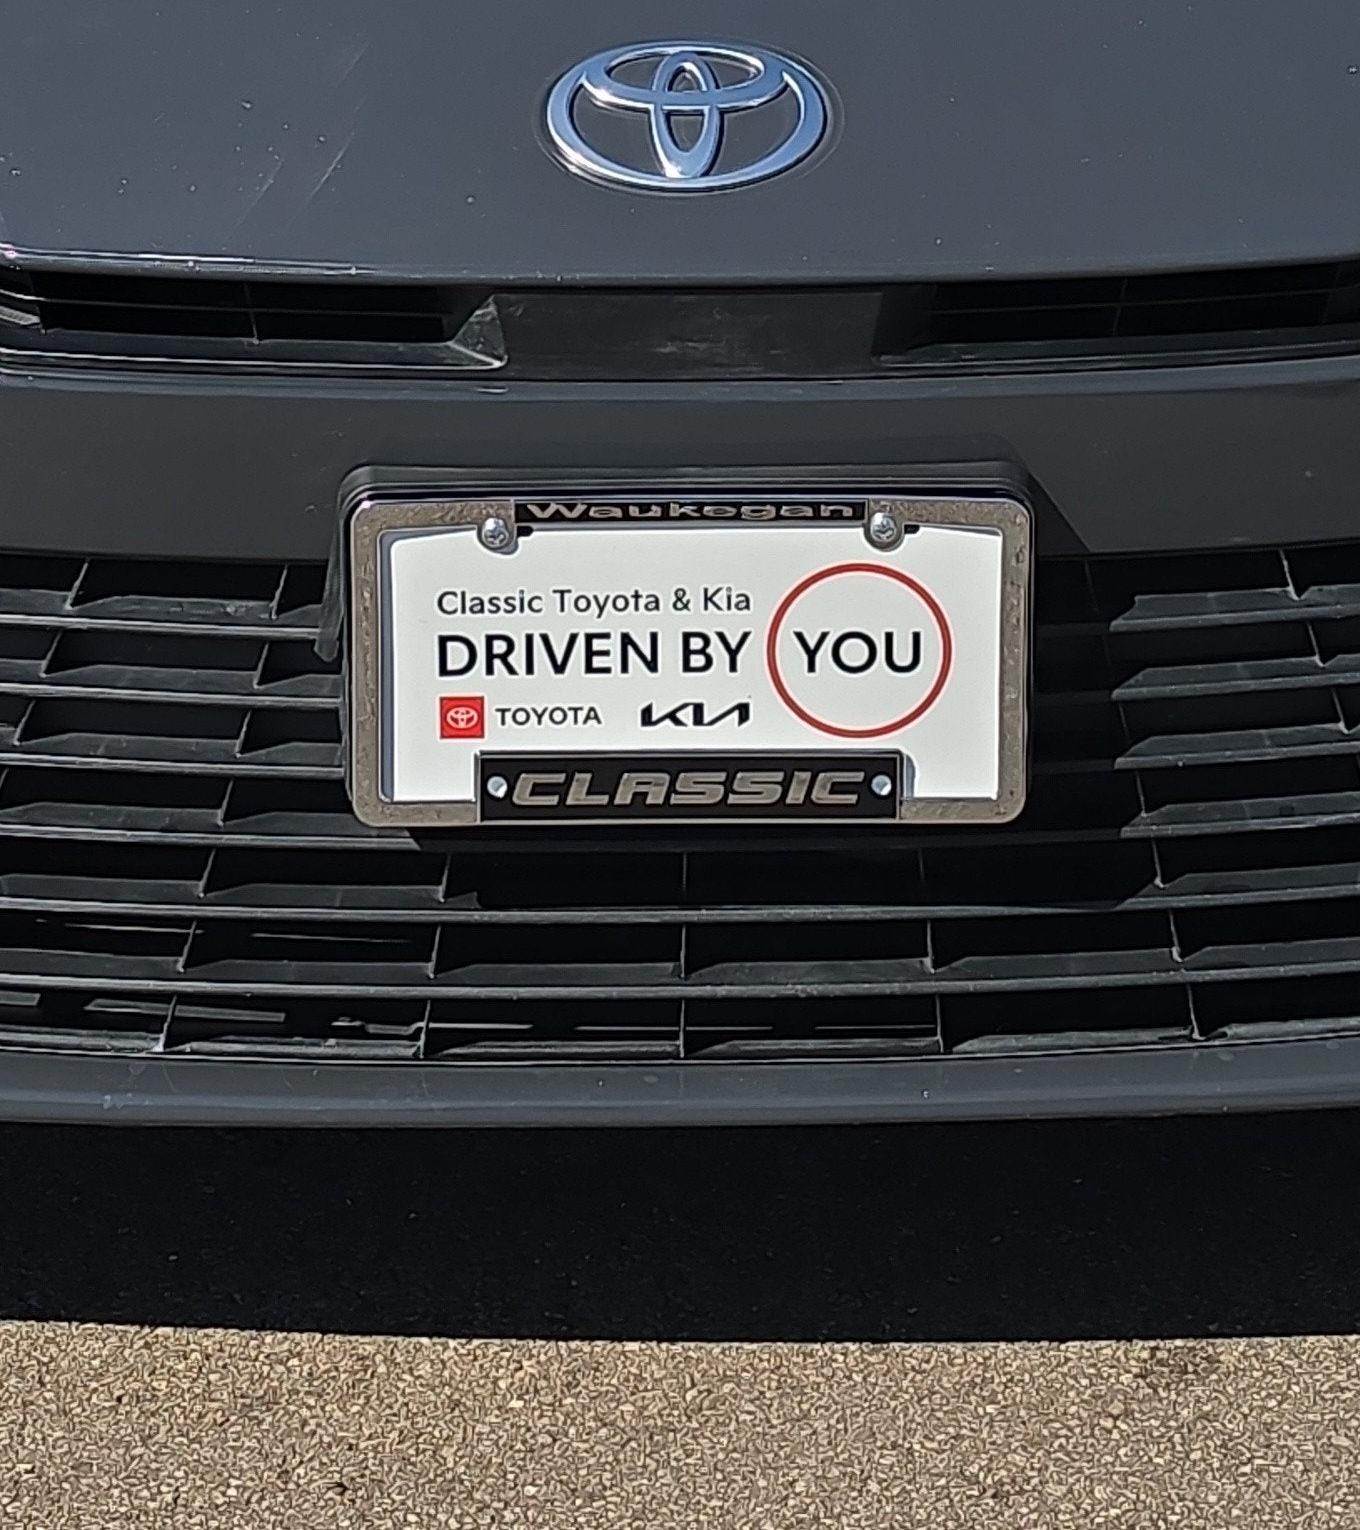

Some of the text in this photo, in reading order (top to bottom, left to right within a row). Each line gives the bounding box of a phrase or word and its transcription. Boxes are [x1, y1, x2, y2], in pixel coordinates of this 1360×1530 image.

[525, 501, 854, 520] Waukegan
[437, 587, 752, 619] Classic Toyota & Kia
[437, 630, 922, 678] DRIVEN BY YOU
[494, 705, 603, 727] TOYOTA
[511, 770, 866, 807] CLASSIC
